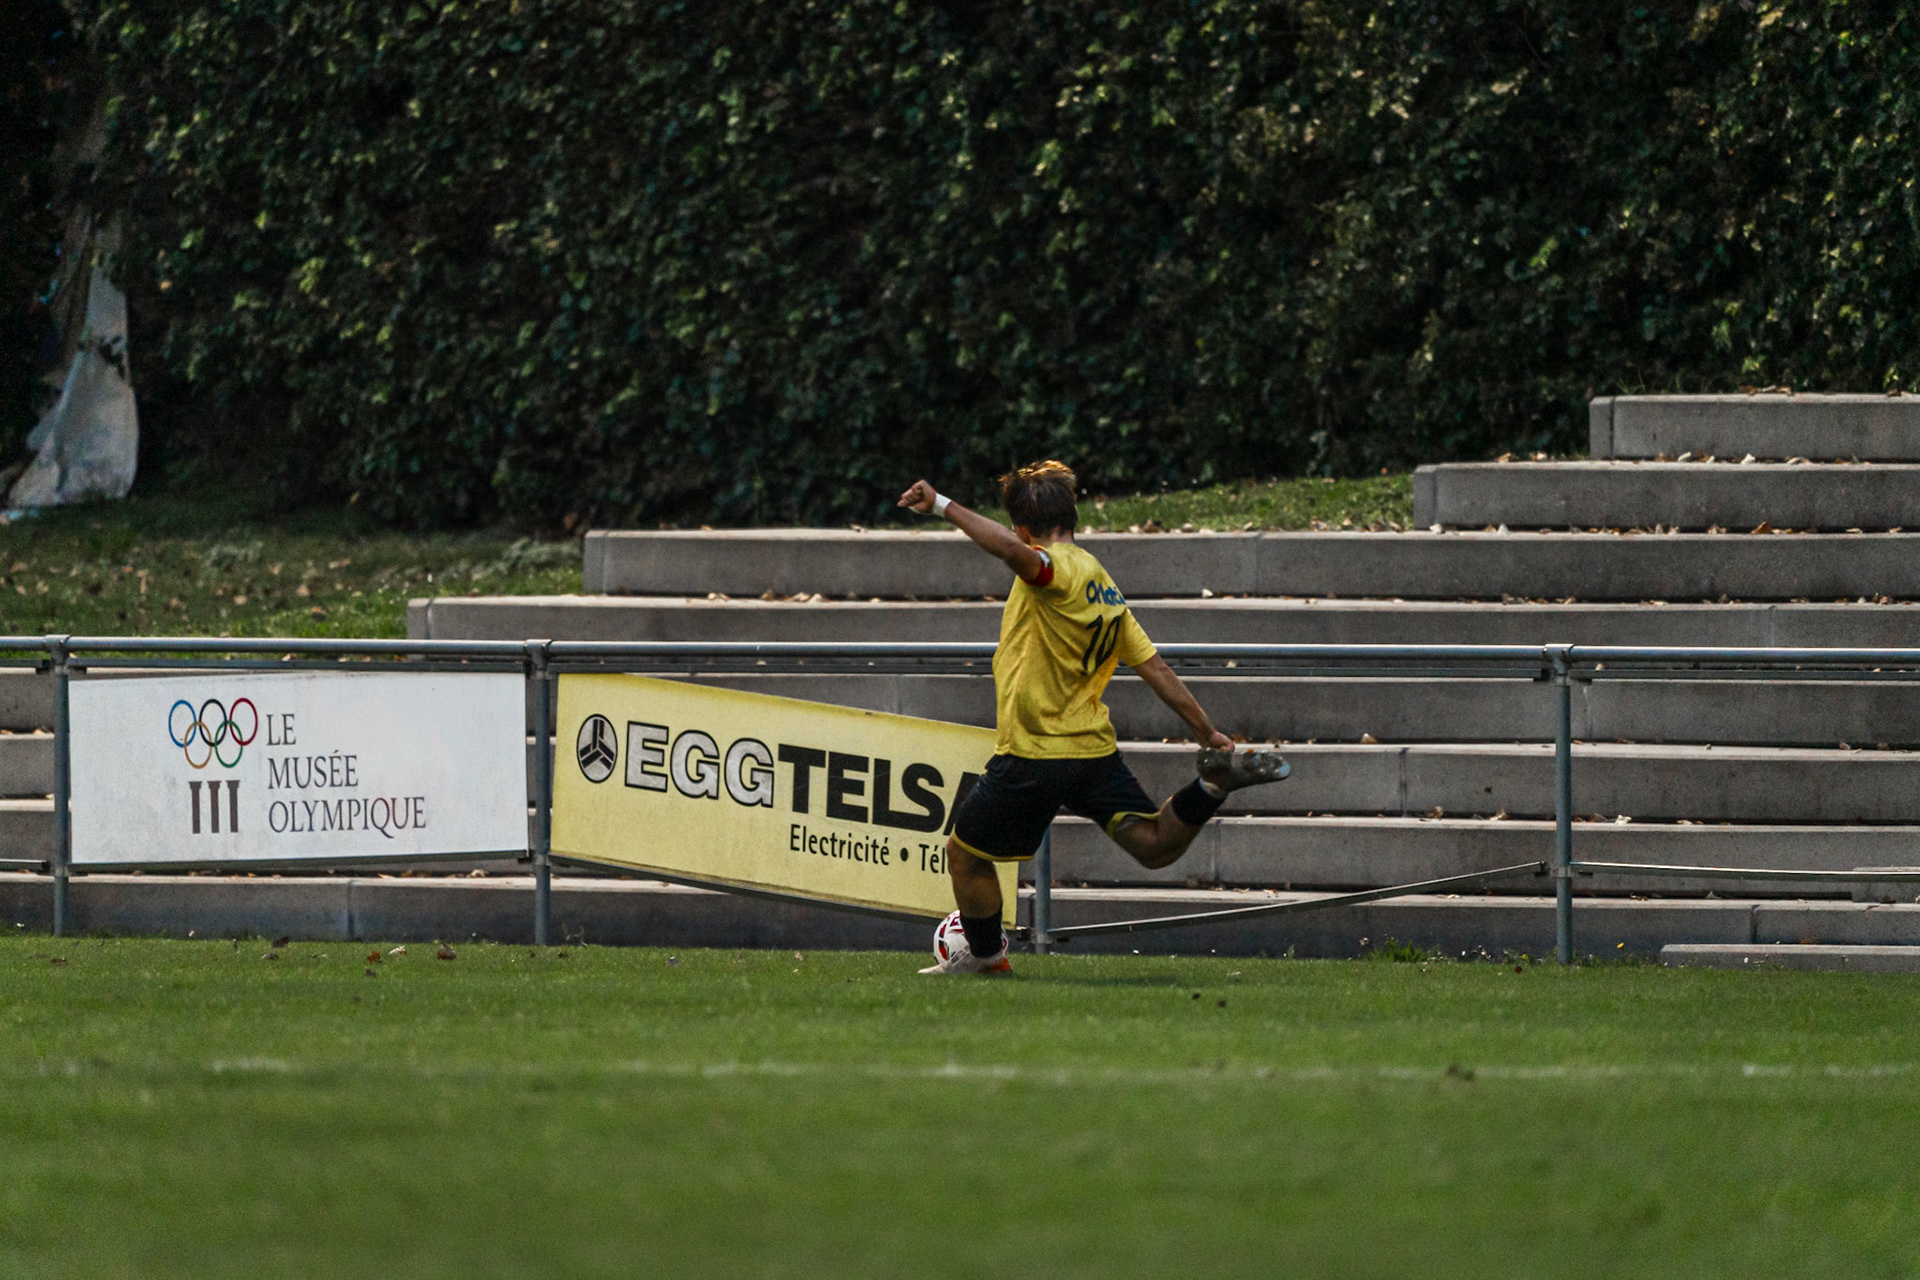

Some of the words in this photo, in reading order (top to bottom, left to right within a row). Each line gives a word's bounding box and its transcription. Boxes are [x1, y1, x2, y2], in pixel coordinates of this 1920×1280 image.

[1081, 614, 1121, 674] 10
[266, 713, 297, 746] LE
[268, 749, 359, 790] MUSÉE
[268, 796, 427, 839] OLYMPIQUE
[789, 824, 890, 866] Electricité
[918, 843, 953, 877] Tél
